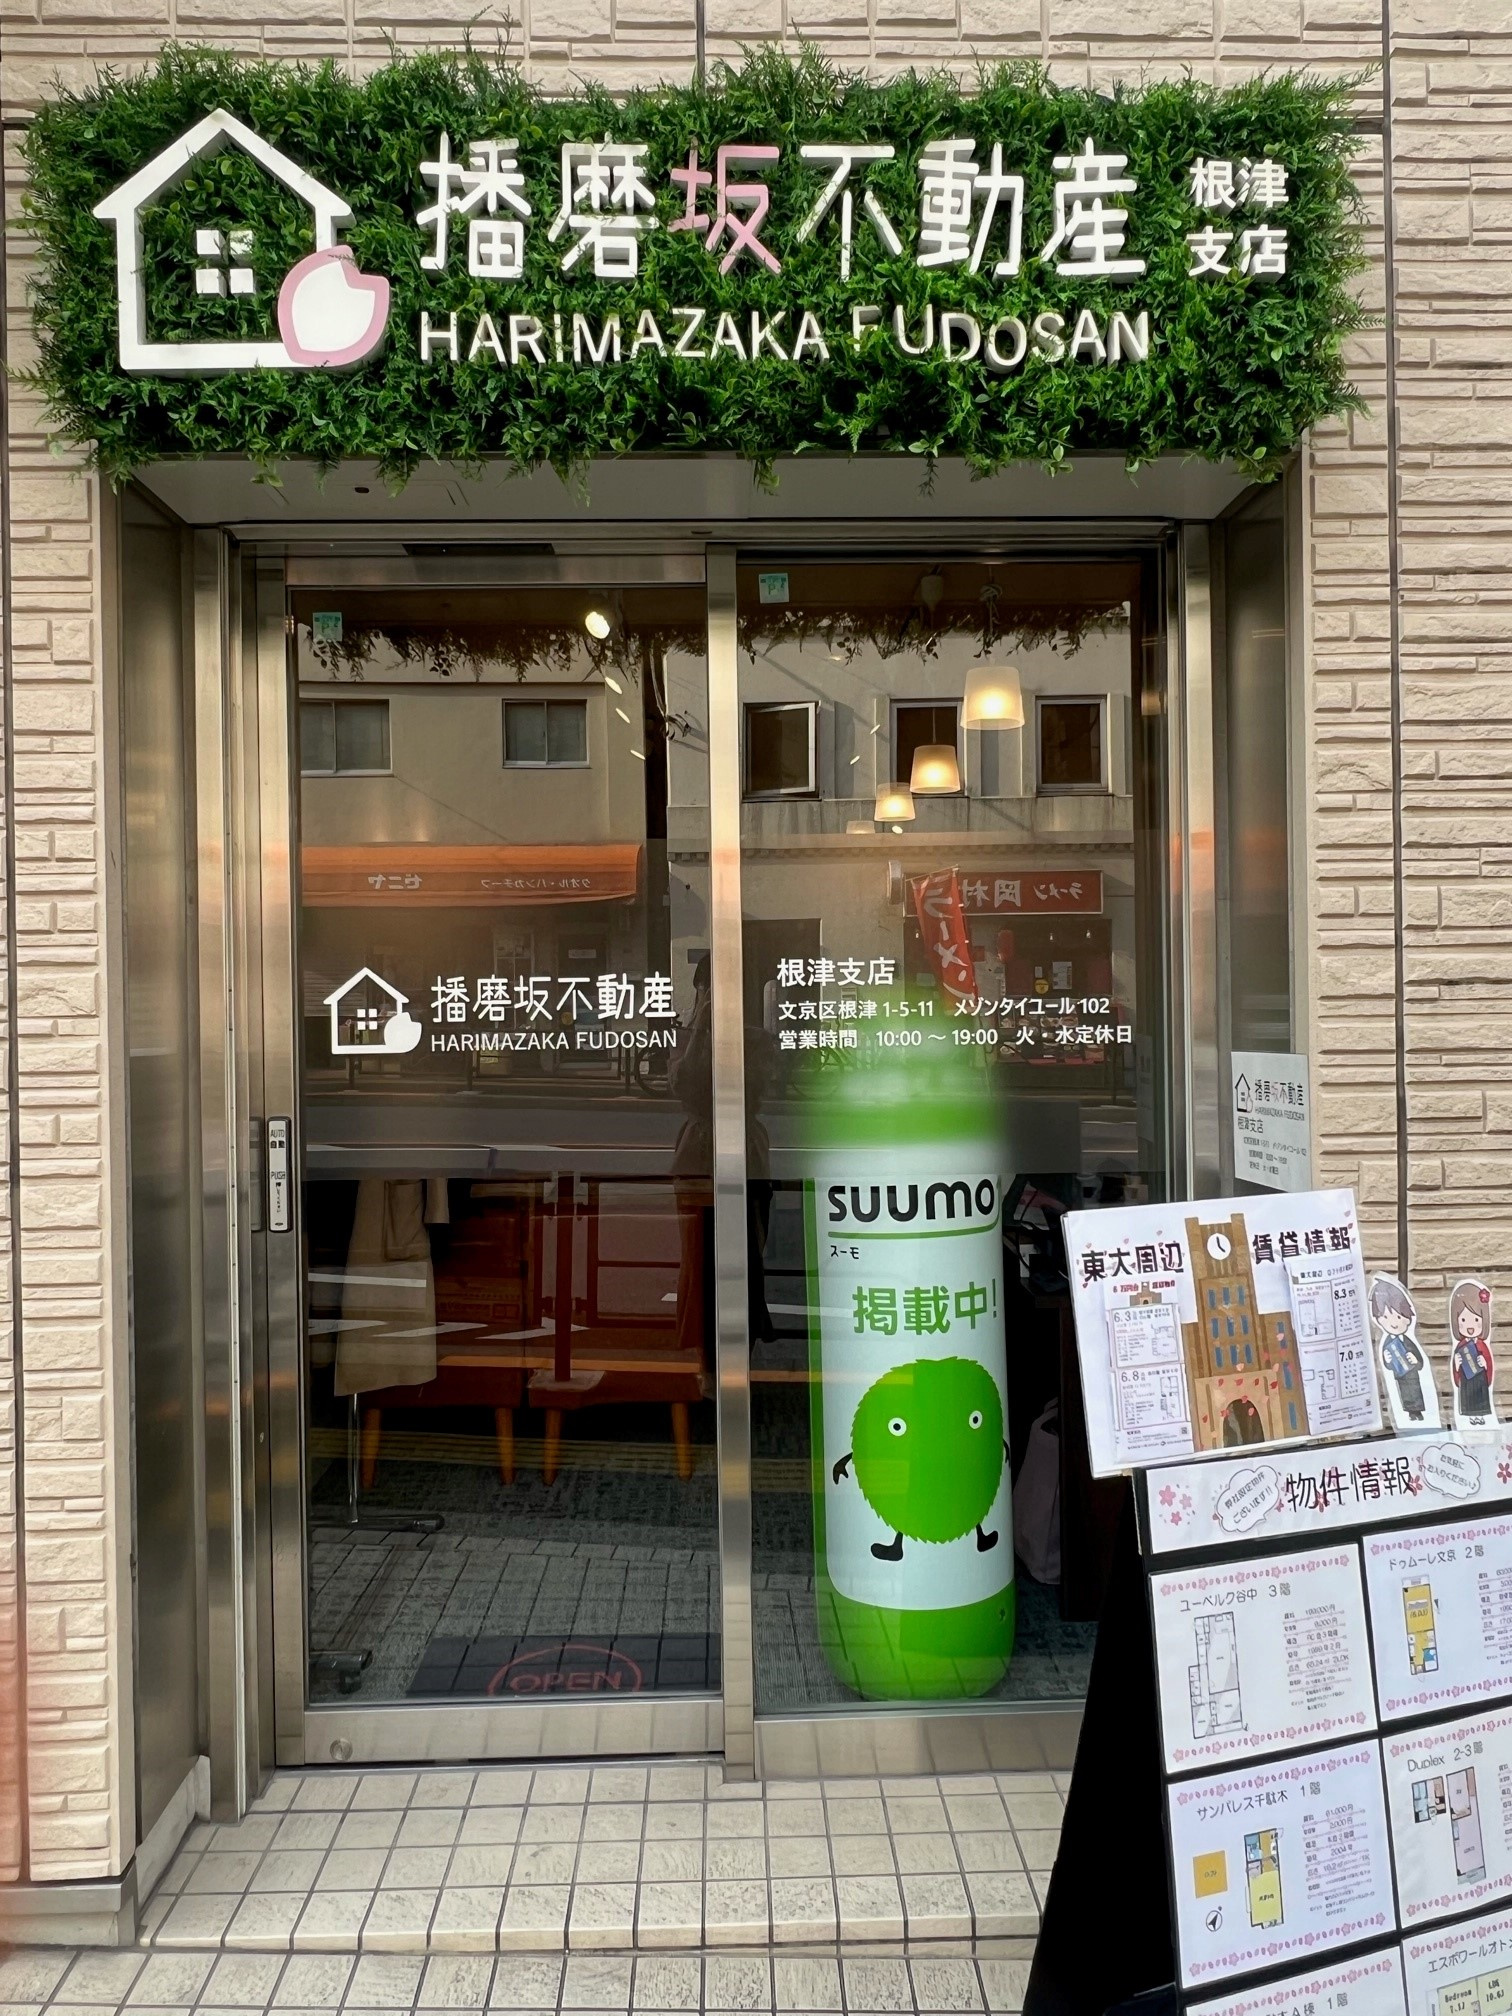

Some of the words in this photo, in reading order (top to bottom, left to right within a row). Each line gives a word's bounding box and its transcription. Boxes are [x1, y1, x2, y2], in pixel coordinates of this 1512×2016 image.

[1189, 157, 1290, 212] 根津
[416, 131, 1146, 282] 播磨坂不動産
[1186, 224, 1289, 281] 支店
[420, 306, 831, 368] HARIMAZAKA
[852, 303, 1149, 373] FUDOSAN
[777, 957, 896, 988] 根津支店
[430, 971, 677, 1023] 播磨坂不動産
[778, 1000, 878, 1021] 文京区根津
[883, 1001, 934, 1018] 1-5-11
[953, 997, 1075, 1017] メゾンタイユール
[1076, 998, 1110, 1015] 102
[430, 1032, 570, 1052] HARIMAZAKA
[576, 1030, 677, 1050] FUDOSAN
[778, 1029, 858, 1050] 営業時間
[877, 1031, 922, 1047] 10:00
[951, 1029, 998, 1046] 19:00
[1015, 1024, 1133, 1045] 火・水定休日
[830, 1245, 860, 1260] スーモ
[1252, 1226, 1352, 1265] 賃貸情報
[1081, 1242, 1185, 1283] 東大周辺
[1334, 1288, 1347, 1300] 8.3
[1114, 1310, 1132, 1323] 6.3
[1339, 1350, 1354, 1362] 7.0
[1121, 1370, 1140, 1383] 6.8
[1286, 1456, 1413, 1513] 物件情報
[509, 1670, 623, 1693] OPEN
